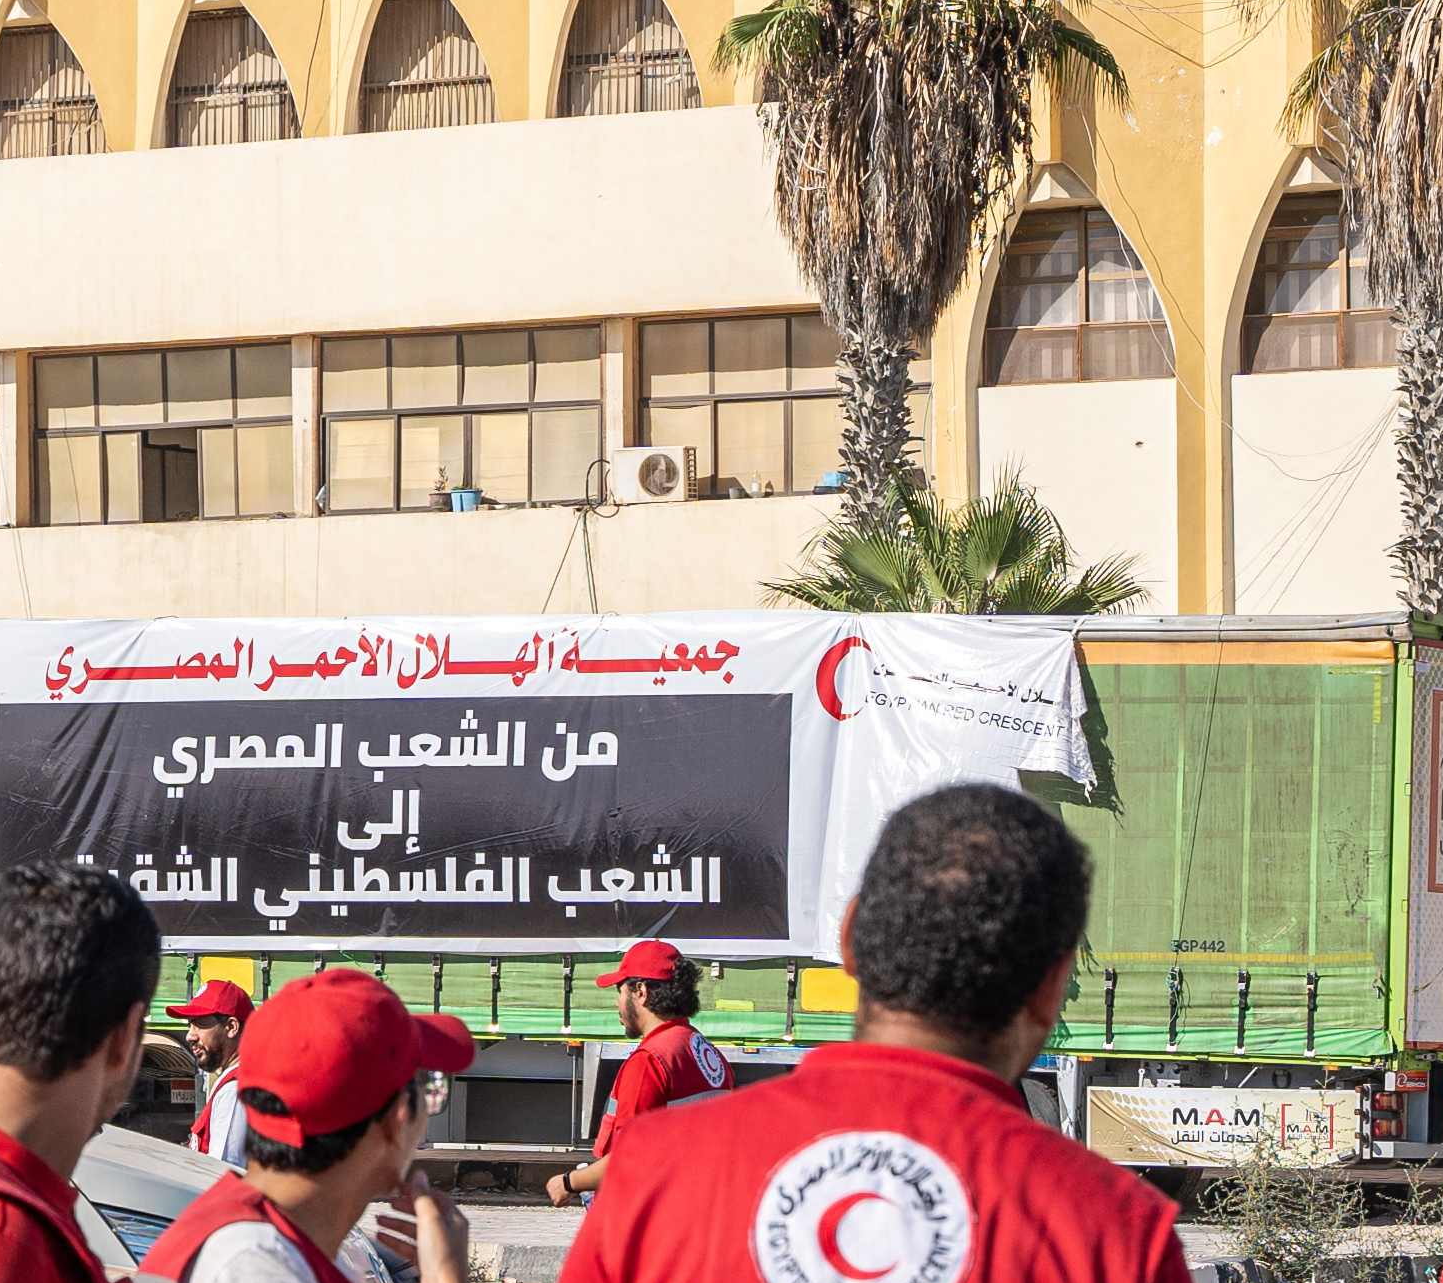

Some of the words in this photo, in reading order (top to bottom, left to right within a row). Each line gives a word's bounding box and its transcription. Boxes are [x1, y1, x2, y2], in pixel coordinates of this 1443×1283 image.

[44, 636, 255, 702] المصري
[253, 626, 394, 692] الأحمر
[396, 630, 556, 689] الهلال
[560, 629, 740, 685] جمعية
[357, 708, 527, 783] الشعب
[540, 721, 619, 782] من
[978, 710, 1066, 738] CRESCENT
[151, 722, 344, 799] المصري
[336, 789, 421, 855] إلى
[253, 851, 531, 932] الفلسطيني
[547, 843, 721, 919] الشعب
[1170, 1129, 1204, 1145] النقل
[1171, 1106, 1261, 1127] M.A.M
[1208, 1130, 1259, 1145] لخدمات
